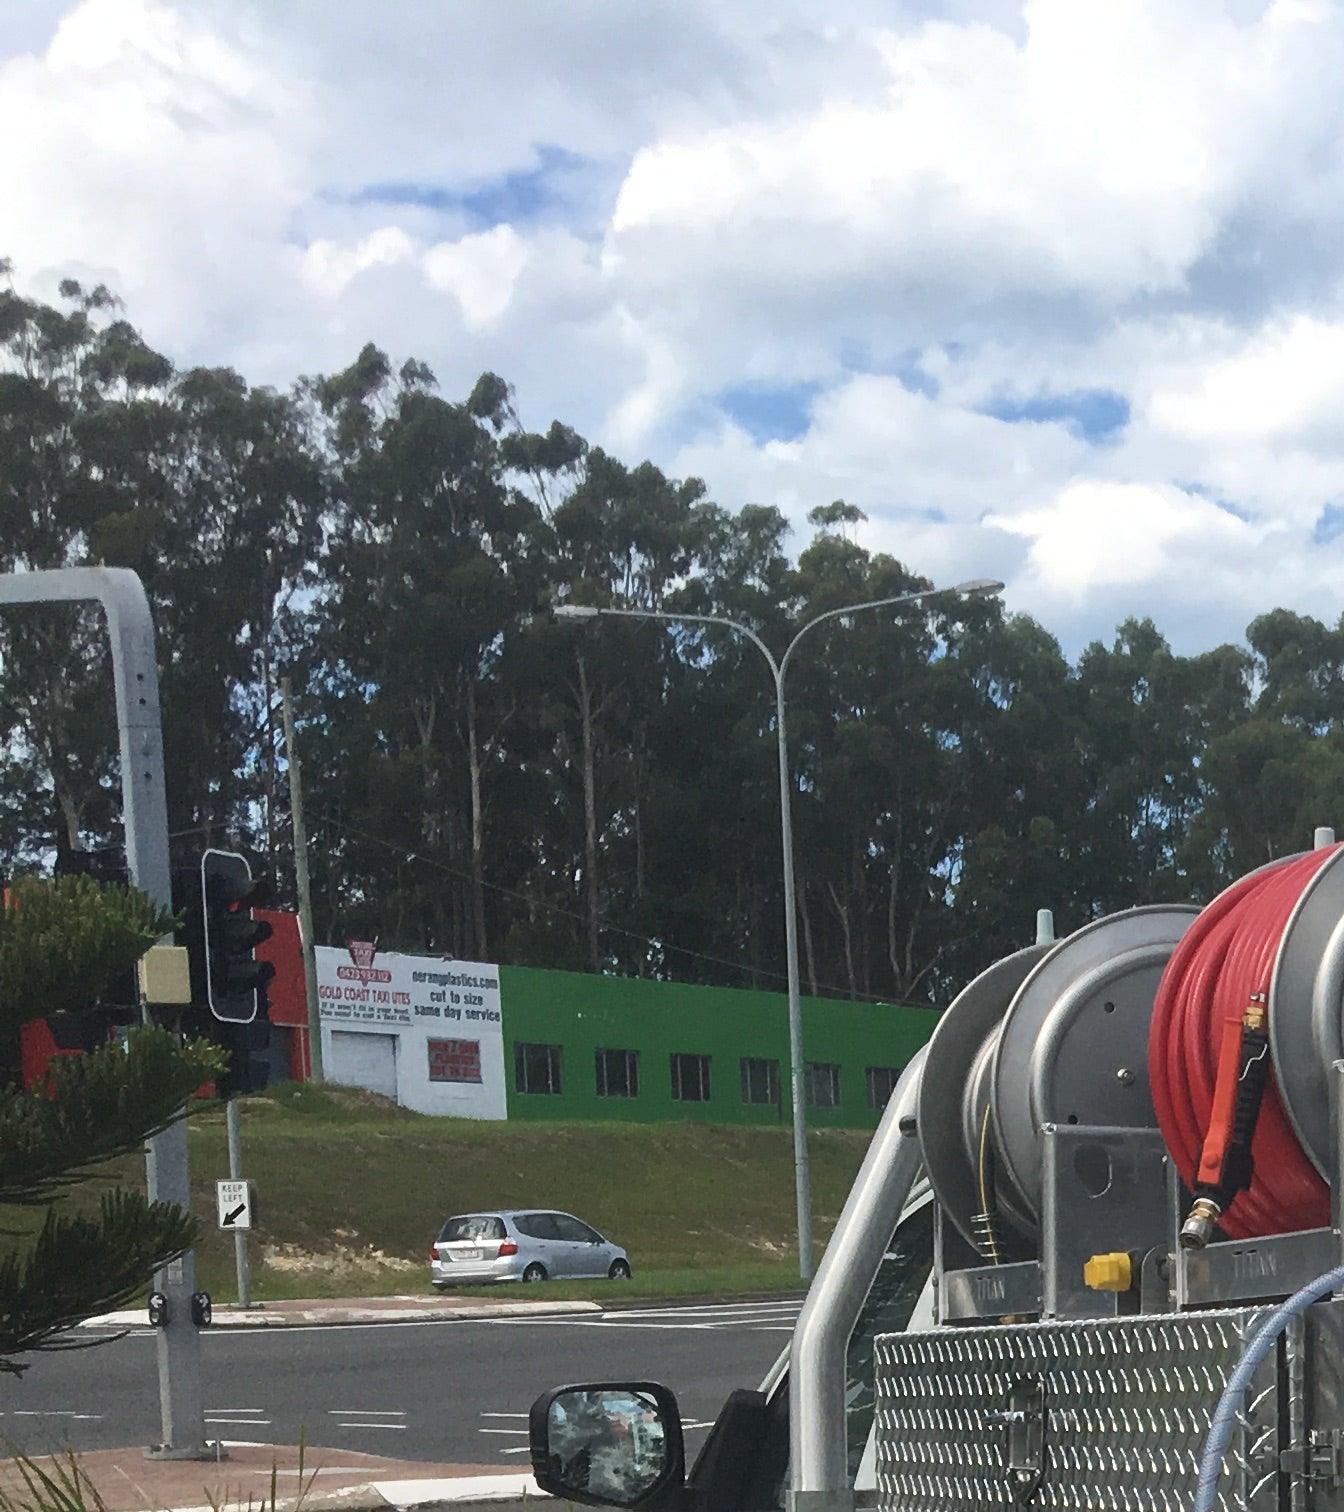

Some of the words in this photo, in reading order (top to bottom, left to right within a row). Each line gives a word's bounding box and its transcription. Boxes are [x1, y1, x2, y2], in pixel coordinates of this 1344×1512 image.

[320, 985, 341, 1000] GOLD
[344, 986, 370, 1001] COAST
[372, 989, 390, 1004] TAXI
[392, 991, 411, 1005] UTES
[430, 990, 447, 1003] cut
[450, 990, 460, 1004] to
[464, 993, 484, 1006] size
[414, 1005, 441, 1017] same
[444, 1005, 461, 1020] day
[465, 1009, 500, 1022] service
[222, 1184, 243, 1193] KEEP
[223, 1194, 243, 1203] LEFT
